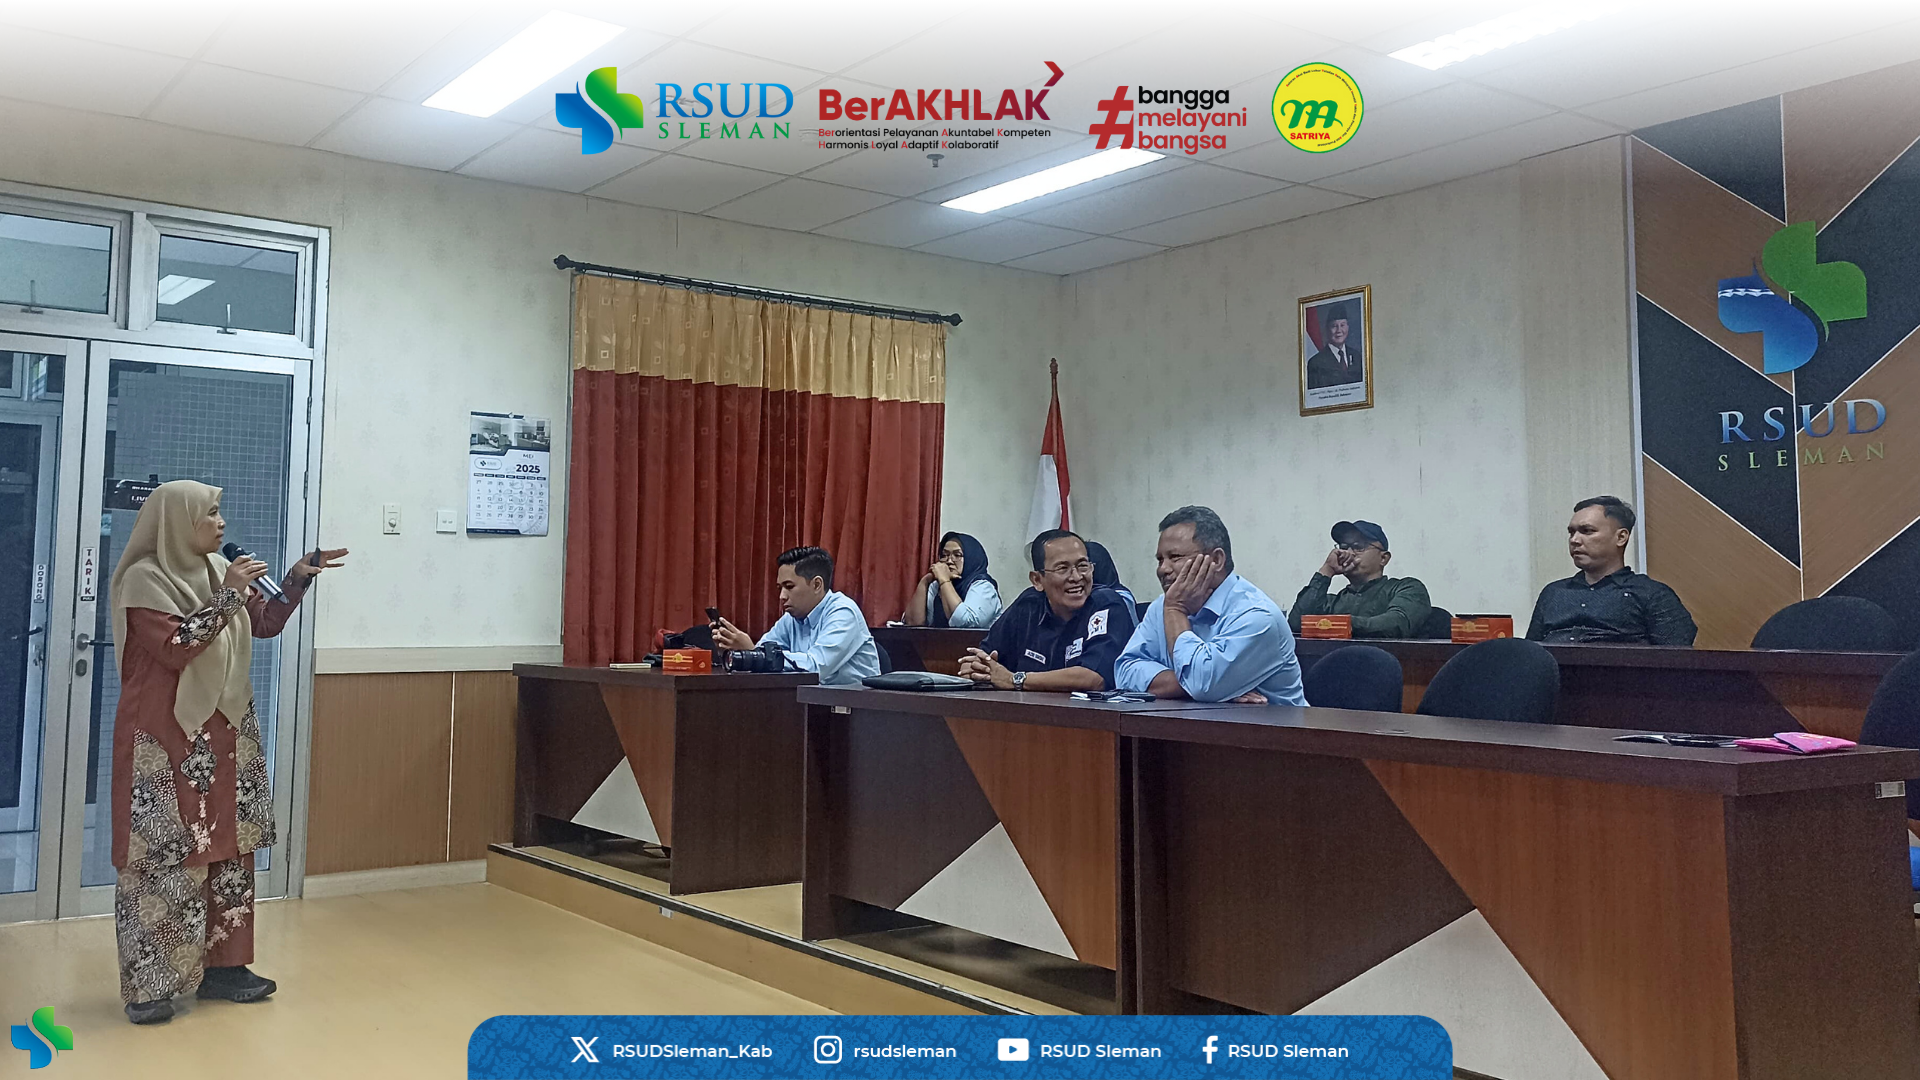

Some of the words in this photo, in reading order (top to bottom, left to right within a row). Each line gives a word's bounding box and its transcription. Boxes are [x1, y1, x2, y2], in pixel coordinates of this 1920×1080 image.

[1718, 397, 1887, 444] RSUD
[516, 464, 540, 473] 2025
[1718, 442, 1885, 473] SLEMAN
[36, 564, 44, 600] DORONG
[85, 548, 93, 595] TARIK
